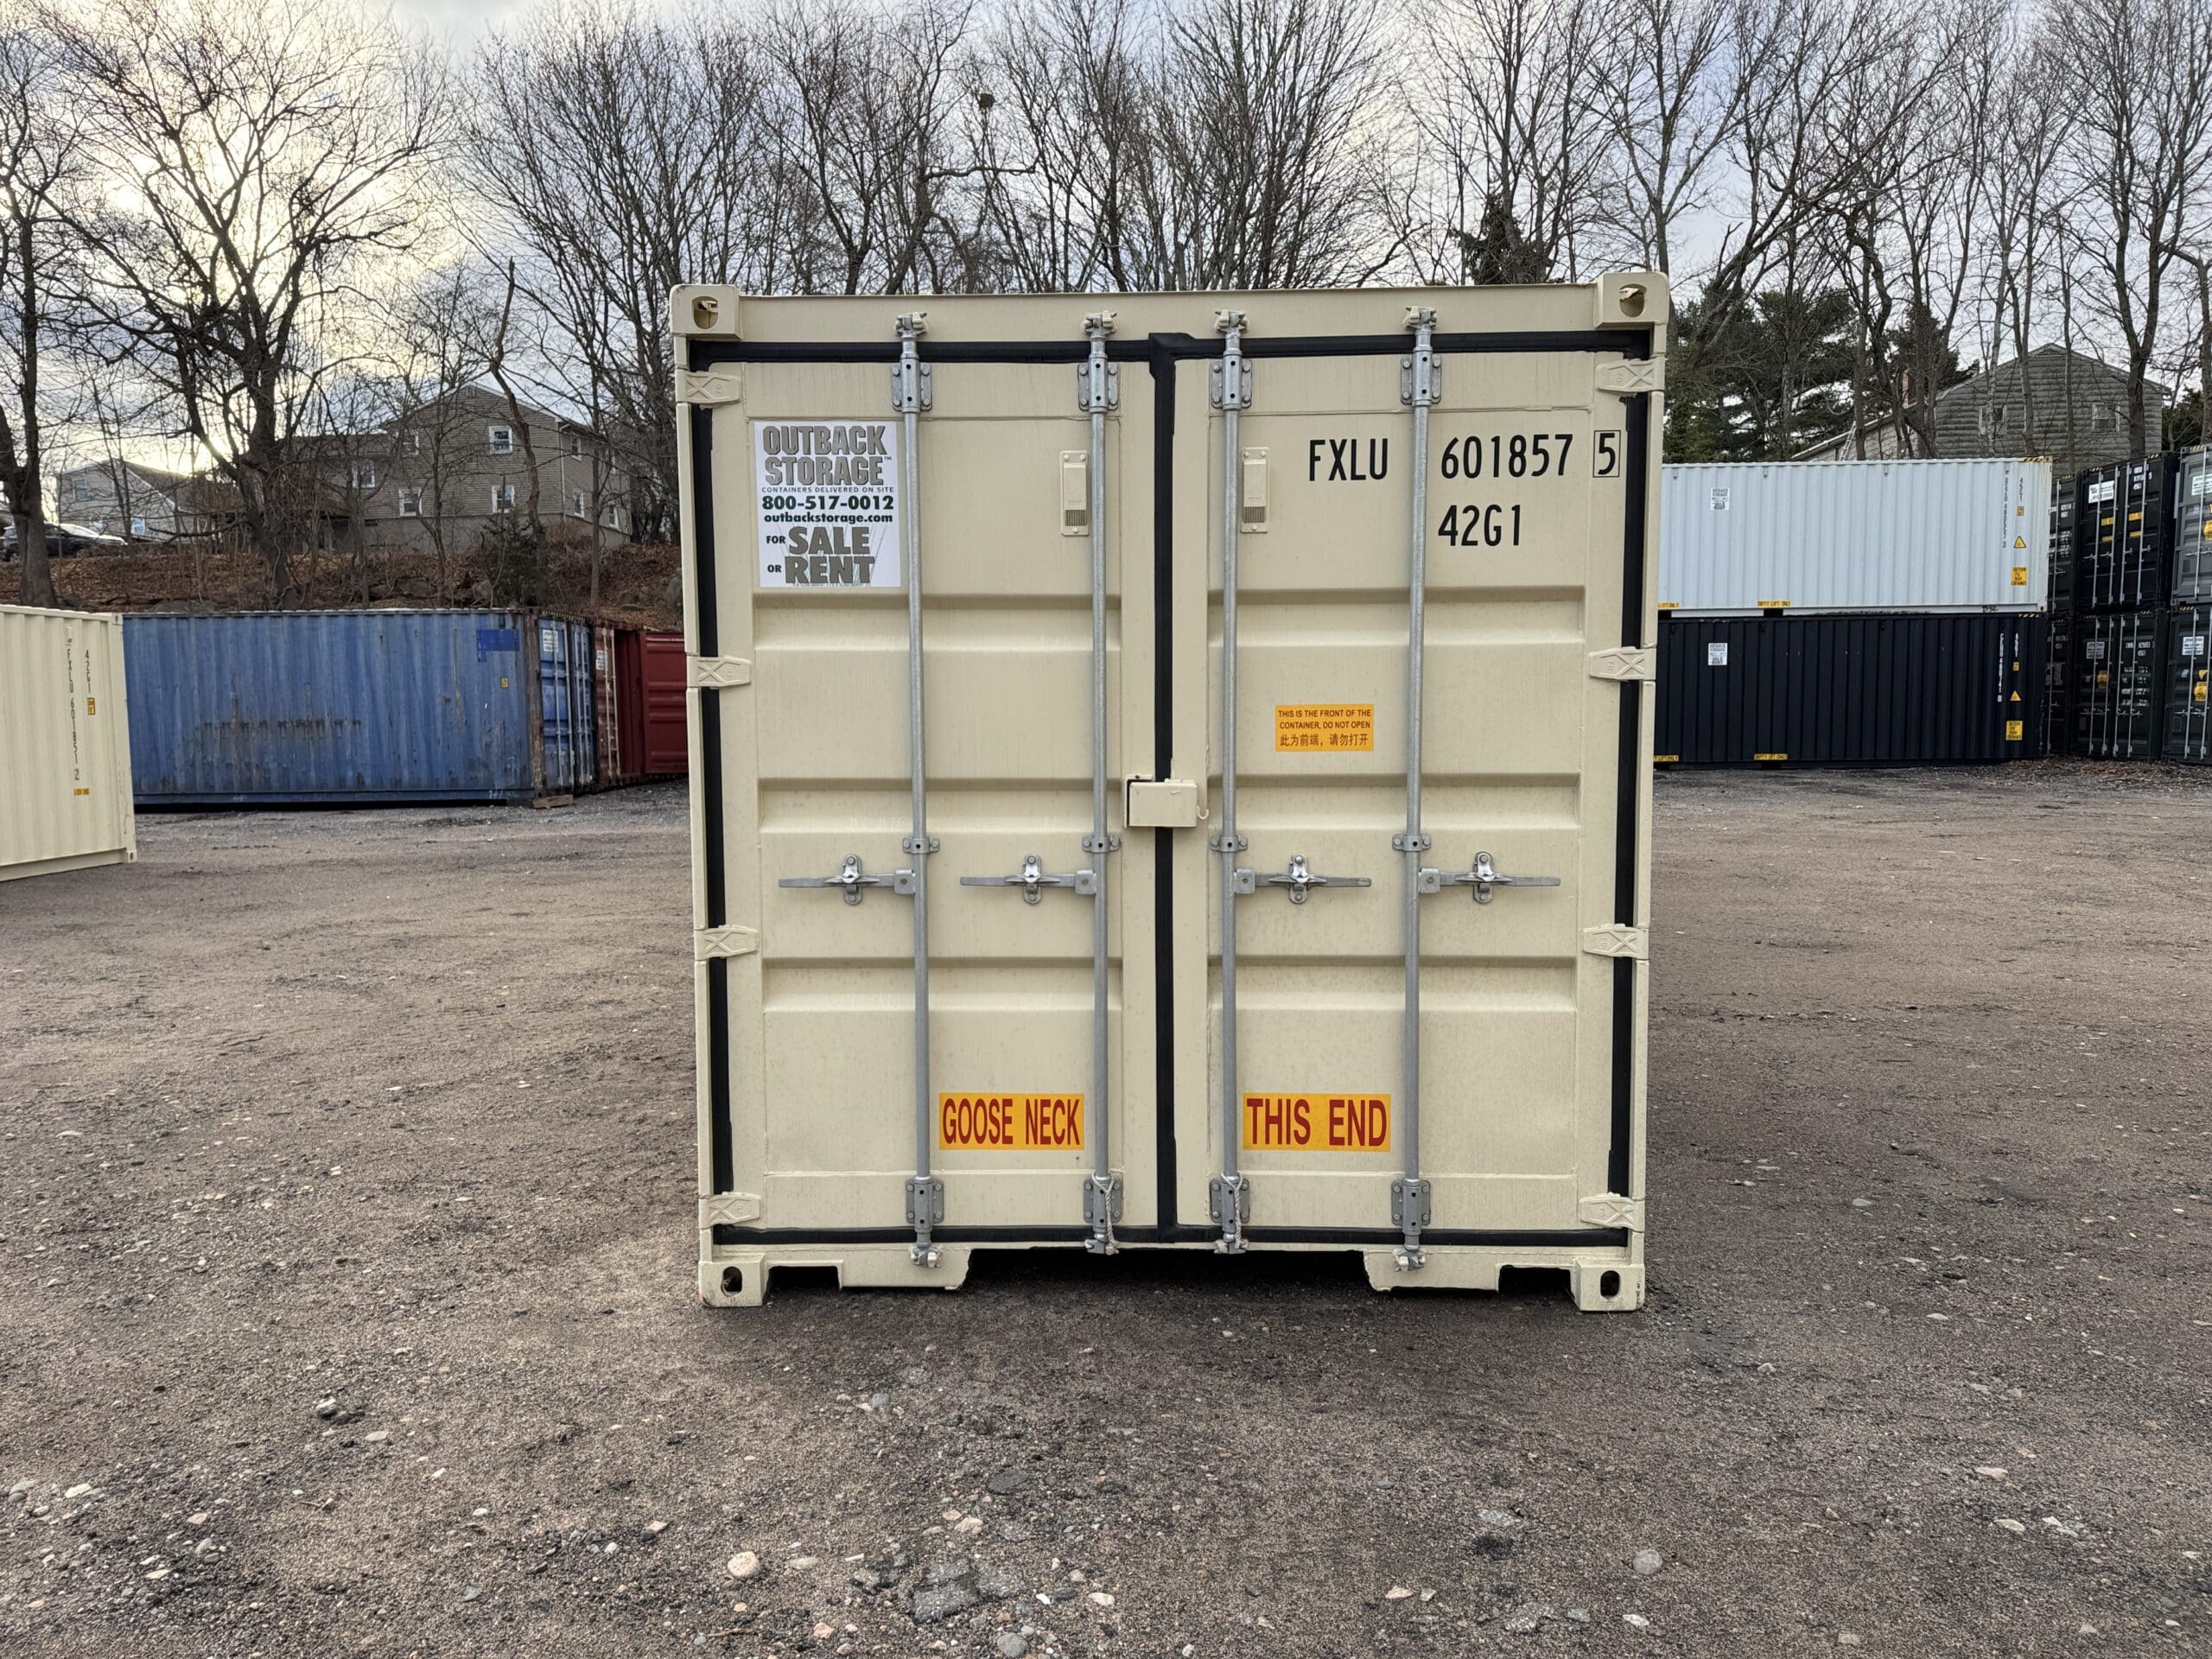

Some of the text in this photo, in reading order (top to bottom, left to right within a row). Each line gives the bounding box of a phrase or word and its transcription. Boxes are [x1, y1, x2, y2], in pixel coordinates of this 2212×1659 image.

[762, 425, 888, 455] OUTBACK
[764, 456, 885, 486] STORAGE
[1309, 432, 1617, 481] FXLU 601857 5
[762, 495, 894, 510] 800-517-0012
[764, 512, 893, 524] outbackstorage.com
[1438, 504, 1521, 547] 42G1
[766, 526, 871, 555] FOR SALE
[767, 556, 875, 584] OR RENT
[942, 1097, 1081, 1146] GOOSE NECK
[1246, 1098, 1388, 1147] THIS END
